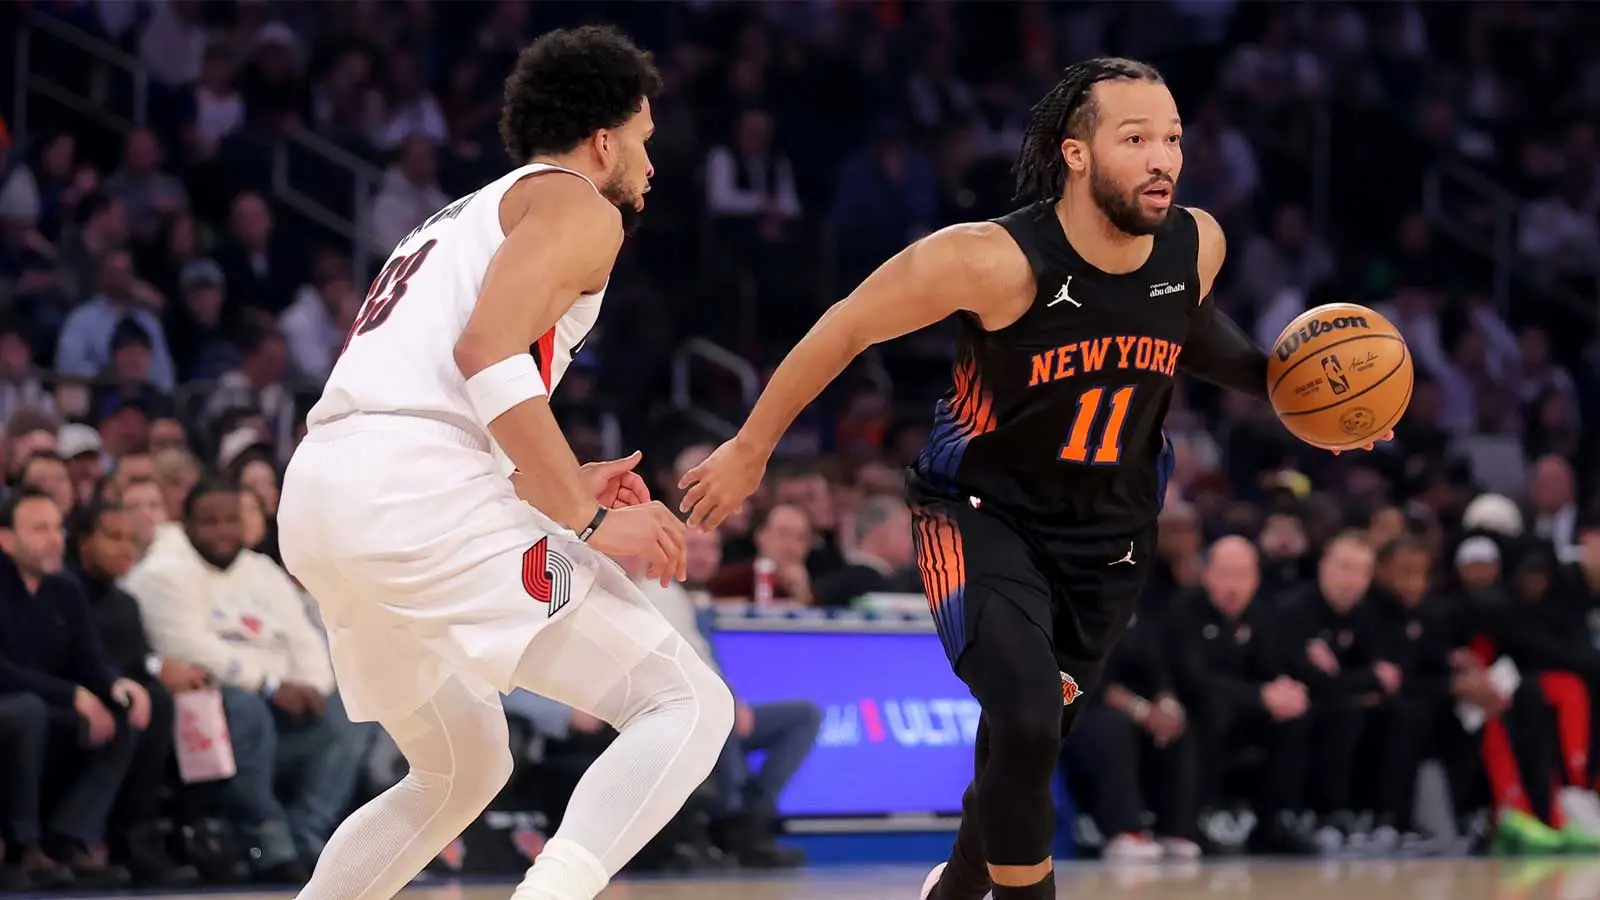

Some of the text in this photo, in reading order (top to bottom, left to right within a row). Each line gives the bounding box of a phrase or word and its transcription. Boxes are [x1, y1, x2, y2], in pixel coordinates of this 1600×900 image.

[1149, 288, 1164, 298] abu
[1164, 282, 1185, 295] dhabi
[1028, 335, 1182, 387] NEW YORK
[1275, 315, 1370, 362] Wilson
[1056, 384, 1139, 465] 11
